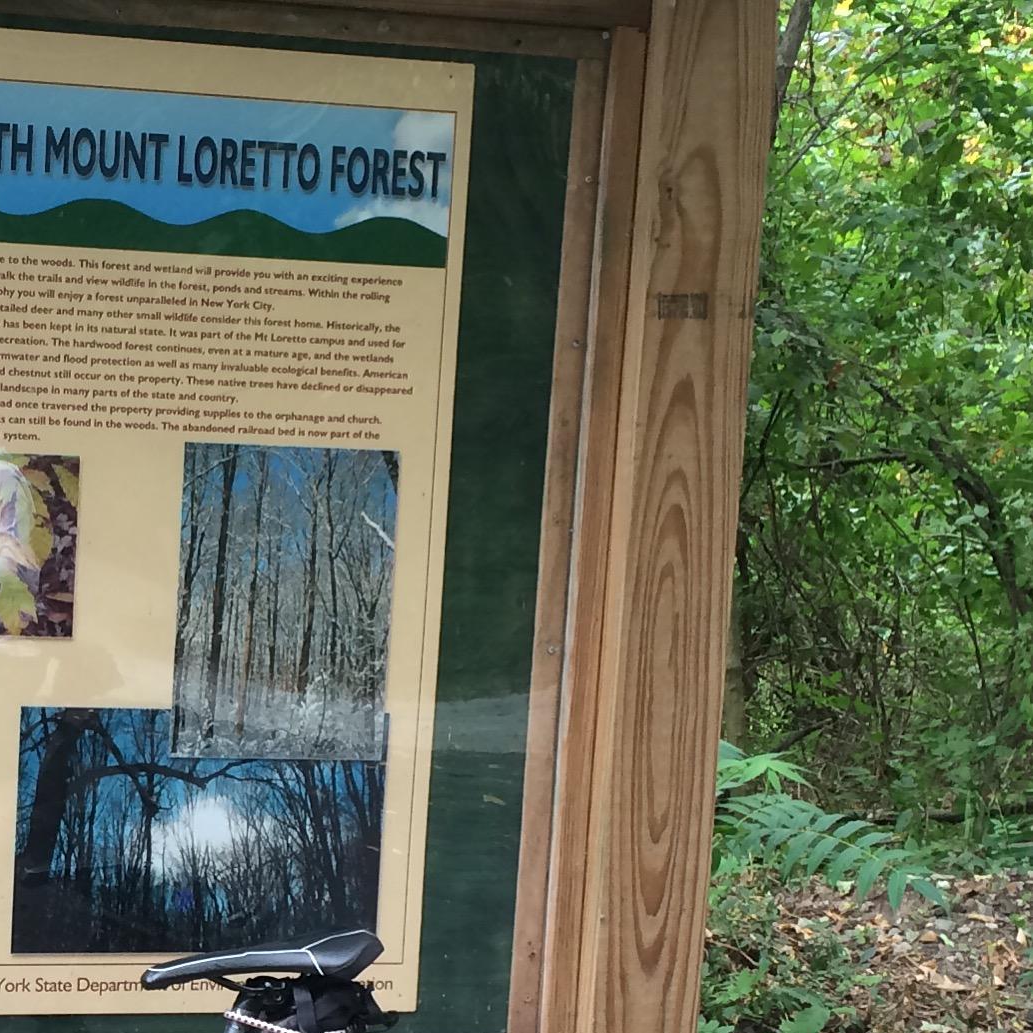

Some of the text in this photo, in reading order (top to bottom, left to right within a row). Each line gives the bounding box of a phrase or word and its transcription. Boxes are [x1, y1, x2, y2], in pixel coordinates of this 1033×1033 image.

[45, 125, 169, 181] MOUNT
[177, 135, 321, 191] LORETTO
[330, 145, 446, 199] FOREST
[8, 255, 19, 265] to
[21, 256, 38, 266] the
[41, 257, 75, 268] woods.
[79, 259, 98, 269] This
[101, 260, 130, 271] forest
[133, 262, 151, 272] and
[153, 263, 192, 275] wetland
[214, 267, 250, 280] provide
[253, 271, 270, 281] you
[273, 270, 294, 280] with
[311, 272, 348, 286] exciting
[351, 275, 402, 289] experience
[18, 271, 34, 282] the
[37, 273, 62, 283] trails
[65, 274, 83, 284] and
[86, 275, 108, 286] view
[148, 279, 157, 288] in
[160, 279, 176, 289] the
[179, 280, 209, 292] forest,
[212, 282, 241, 295] ponds
[244, 284, 262, 294] and
[264, 285, 305, 297] streams.
[308, 288, 339, 298] Within
[342, 290, 357, 299] the
[360, 290, 390, 303] rolling
[17, 290, 35, 300] you
[57, 292, 84, 303] enjoy
[95, 292, 123, 303] forest
[127, 293, 186, 308] unparalleled
[189, 297, 197, 307] in
[201, 297, 223, 308] New
[226, 299, 249, 309] York
[252, 300, 274, 313] City.
[30, 304, 53, 315] deer
[56, 306, 74, 316] and
[77, 309, 103, 319] many
[106, 308, 133, 319] other
[136, 310, 161, 320] small
[200, 313, 241, 324] consider
[244, 315, 261, 325] this
[264, 317, 290, 327] forest
[294, 318, 322, 329] home.
[326, 320, 381, 334] Historically,
[385, 323, 400, 333] the
[42, 352, 60, 363] and
[63, 353, 87, 364] flood
[91, 355, 141, 369] protection
[157, 358, 176, 368] well
[179, 361, 189, 369] as
[192, 362, 218, 372] many
[221, 361, 268, 373] invaluable
[271, 364, 317, 377] ecological
[320, 366, 359, 377] benefits.
[362, 368, 408, 379] American
[0, 382, 48, 396] landscape
[51, 385, 60, 394] in
[63, 387, 89, 398] many
[92, 387, 117, 399] parts
[120, 388, 130, 398] of
[132, 388, 148, 398] the
[151, 389, 175, 400] state
[178, 390, 196, 401] and
[198, 391, 238, 405] country.
[8, 367, 50, 378] chestnut
[54, 369, 71, 379] still
[73, 372, 101, 380] occur
[119, 372, 134, 382] the
[138, 373, 183, 386] property.
[185, 375, 214, 386] These
[217, 377, 246, 387] native
[249, 378, 273, 388] trees
[277, 379, 298, 390] have
[301, 381, 340, 392] declined
[356, 383, 413, 397] disappeared
[15, 401, 38, 409] once
[41, 400, 88, 411] traversed
[91, 402, 106, 412] the
[109, 403, 152, 416] property
[155, 405, 200, 419] providing
[203, 407, 240, 420] supplies
[243, 409, 253, 419] to
[256, 410, 272, 420] the
[275, 411, 324, 424] orphanage
[327, 413, 344, 423] and
[347, 414, 381, 424] church.
[3, 430, 40, 443] system.
[8, 416, 25, 424] can
[28, 415, 45, 425] still
[48, 416, 60, 426] be
[63, 417, 91, 427] found
[93, 418, 103, 428] in
[105, 418, 121, 428] the
[124, 419, 158, 430] woods.
[161, 421, 179, 431] The
[182, 422, 235, 433] abandoned
[237, 424, 275, 435] railroad
[277, 426, 295, 436] bed
[298, 427, 305, 436] is
[307, 429, 327, 437] now
[330, 428, 349, 440] part
[352, 429, 362, 439] of
[364, 430, 379, 439] the
[35, 978, 73, 993] State
[77, 978, 165, 996] Departm
